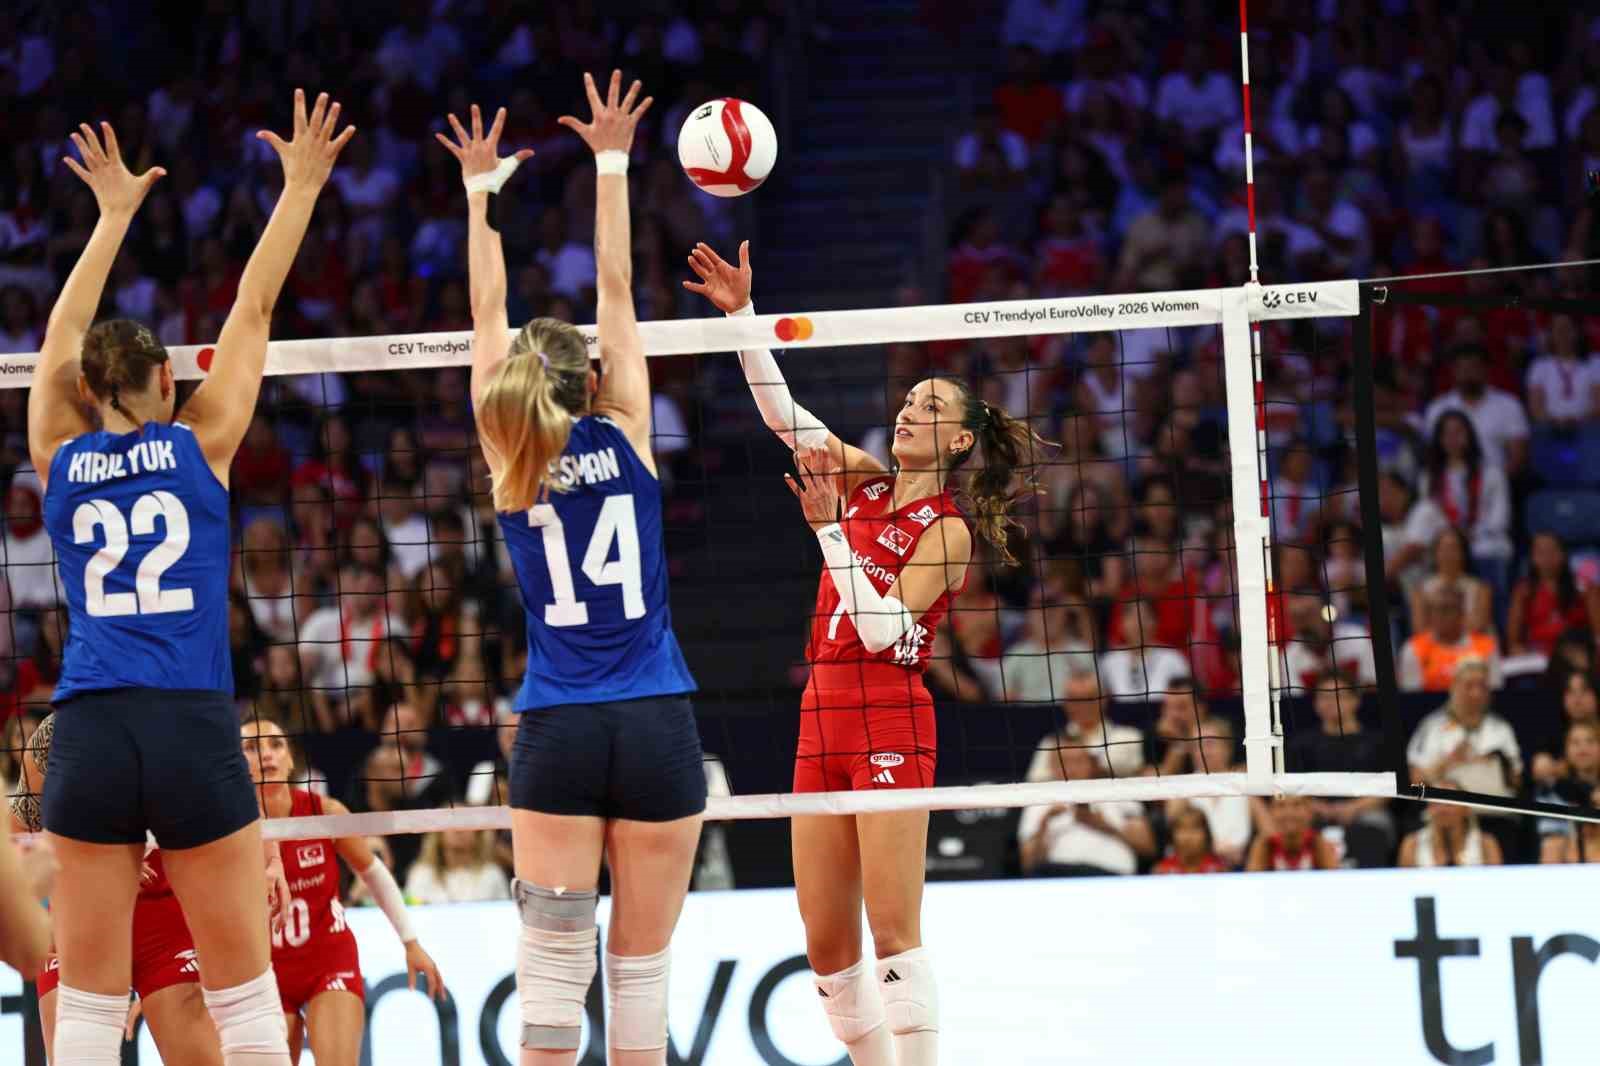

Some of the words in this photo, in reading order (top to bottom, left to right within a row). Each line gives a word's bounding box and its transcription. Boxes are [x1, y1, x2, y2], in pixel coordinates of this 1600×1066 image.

[964, 312, 990, 323] CEV
[992, 308, 1046, 322] Trendyol
[1049, 304, 1114, 318] EuroVolley
[1118, 302, 1149, 315] 2026
[1151, 300, 1199, 313] Women
[1285, 292, 1317, 304] CEV
[388, 343, 414, 355] CEV
[416, 339, 470, 354] Trendyol
[0, 362, 35, 374] Wome
[547, 447, 620, 486] SMAN
[72, 490, 194, 617] 22
[527, 493, 647, 627] 14
[852, 550, 896, 585] afone
